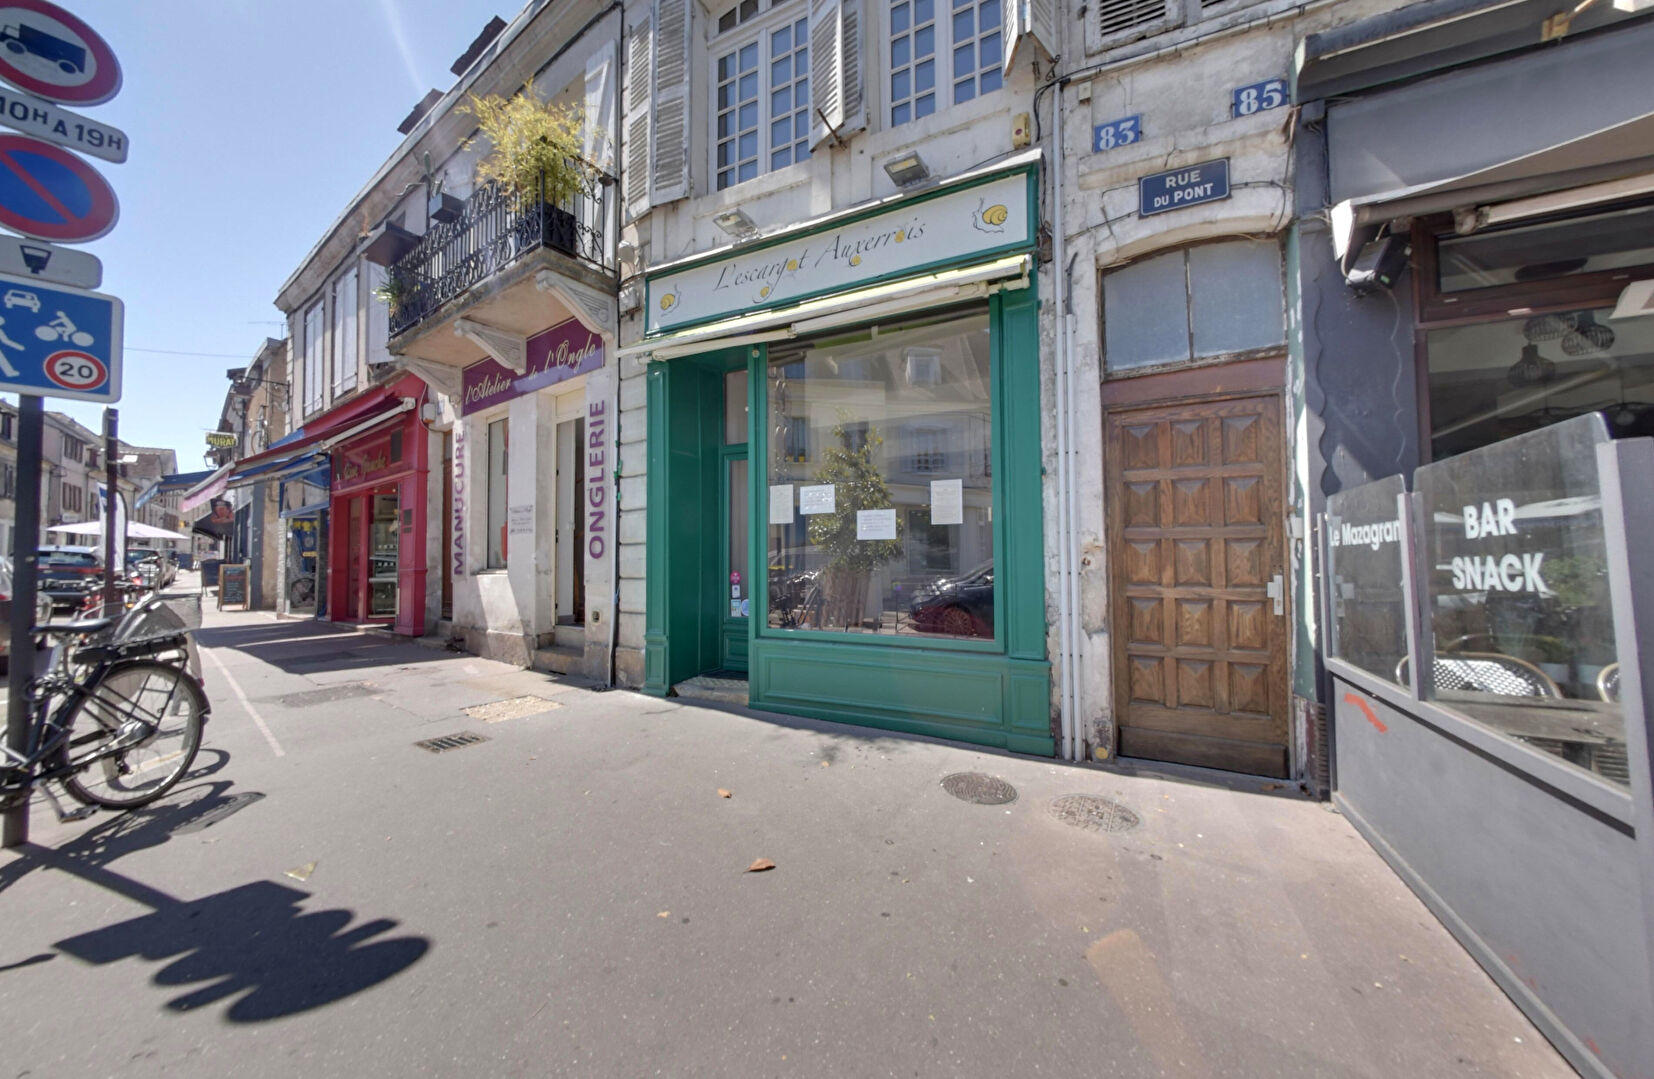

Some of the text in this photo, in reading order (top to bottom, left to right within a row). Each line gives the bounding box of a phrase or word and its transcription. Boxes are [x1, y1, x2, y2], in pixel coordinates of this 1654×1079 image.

[1239, 82, 1283, 115] 85
[52, 119, 68, 137] A
[75, 124, 122, 150] 19H
[1099, 119, 1136, 151] 83
[1165, 169, 1201, 188] RUE
[1153, 183, 1214, 208] DU PONT
[713, 216, 926, 304] L'escargot Auxerrois
[59, 362, 93, 379] 20
[528, 365, 539, 380] de
[544, 333, 597, 374] l'Ongle
[589, 399, 605, 559] ONGLERIE
[454, 430, 465, 576] MANUCURE
[1463, 498, 1518, 540] BAR
[1329, 520, 1400, 551] Le Mazagran
[1452, 552, 1551, 594] SNACK
